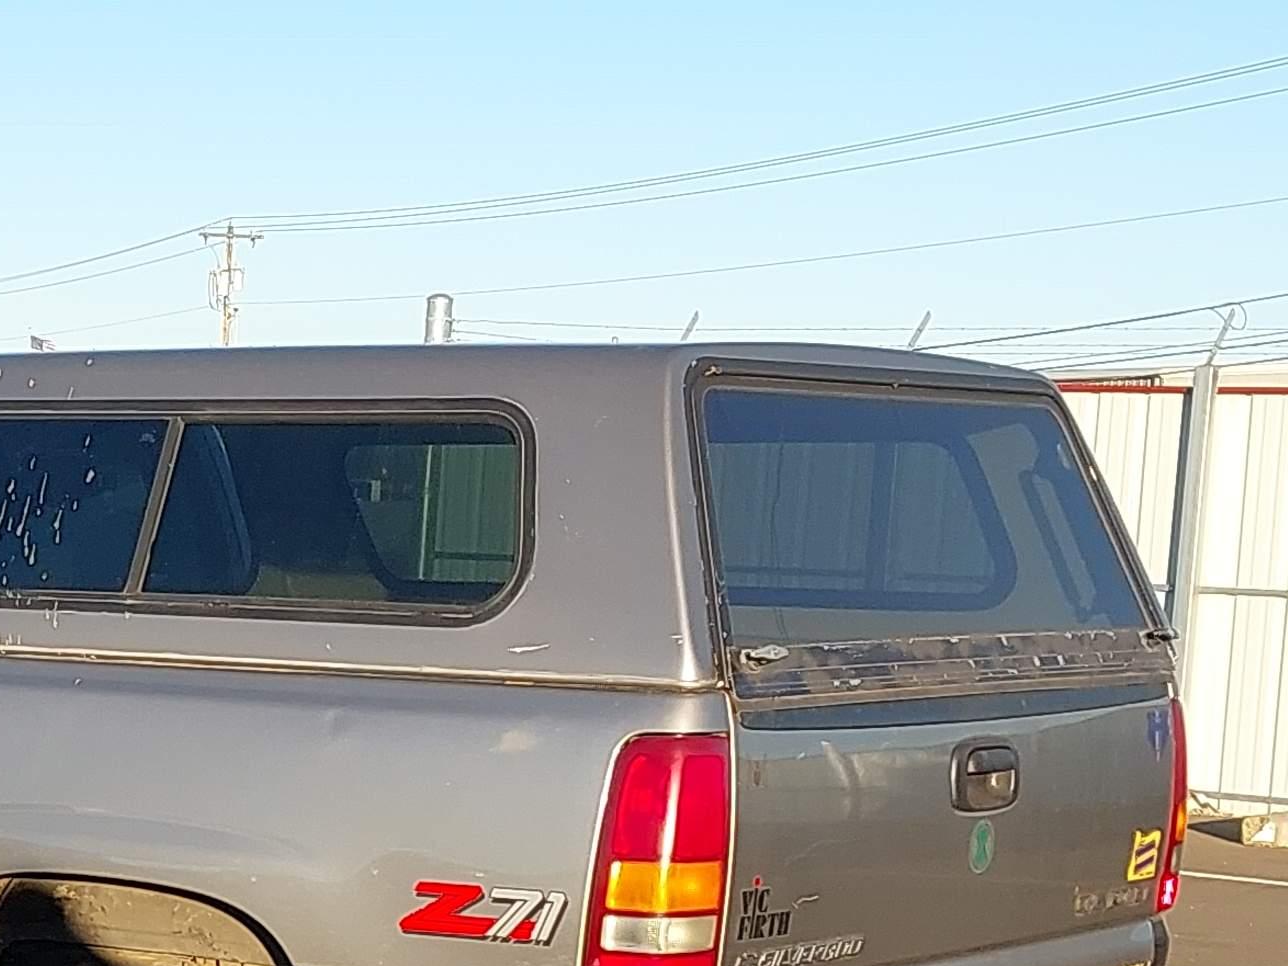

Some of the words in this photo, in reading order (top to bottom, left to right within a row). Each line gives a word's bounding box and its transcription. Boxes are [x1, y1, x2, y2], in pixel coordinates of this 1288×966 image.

[398, 880, 569, 947] Z71
[741, 876, 771, 915] VIC
[737, 910, 792, 941] FIRTH
